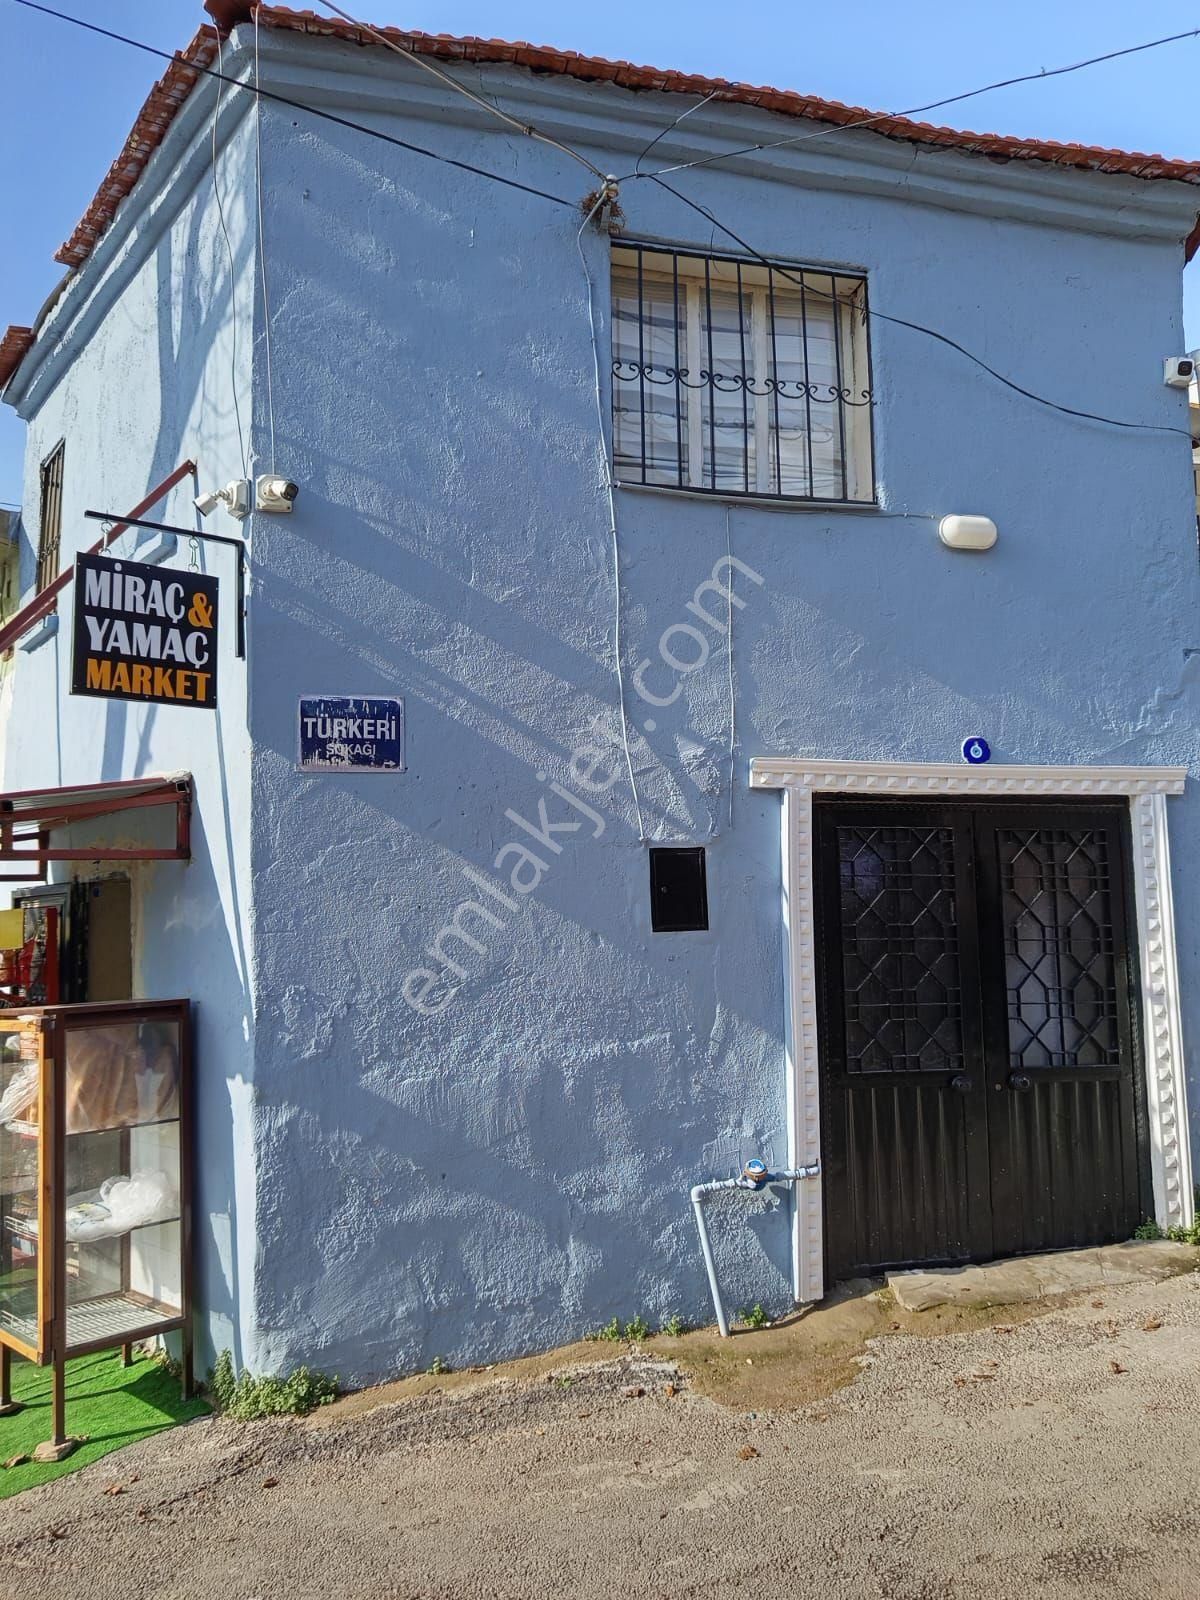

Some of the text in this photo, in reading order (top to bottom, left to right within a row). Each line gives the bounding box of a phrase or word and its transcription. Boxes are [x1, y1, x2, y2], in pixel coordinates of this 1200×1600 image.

[84, 562, 214, 629] MİRAÇ &
[84, 615, 209, 669] YAMAÇ
[86, 658, 212, 702] MARKET
[303, 713, 396, 740] TÜRKERİ
[325, 741, 376, 756] SOKAĞI
